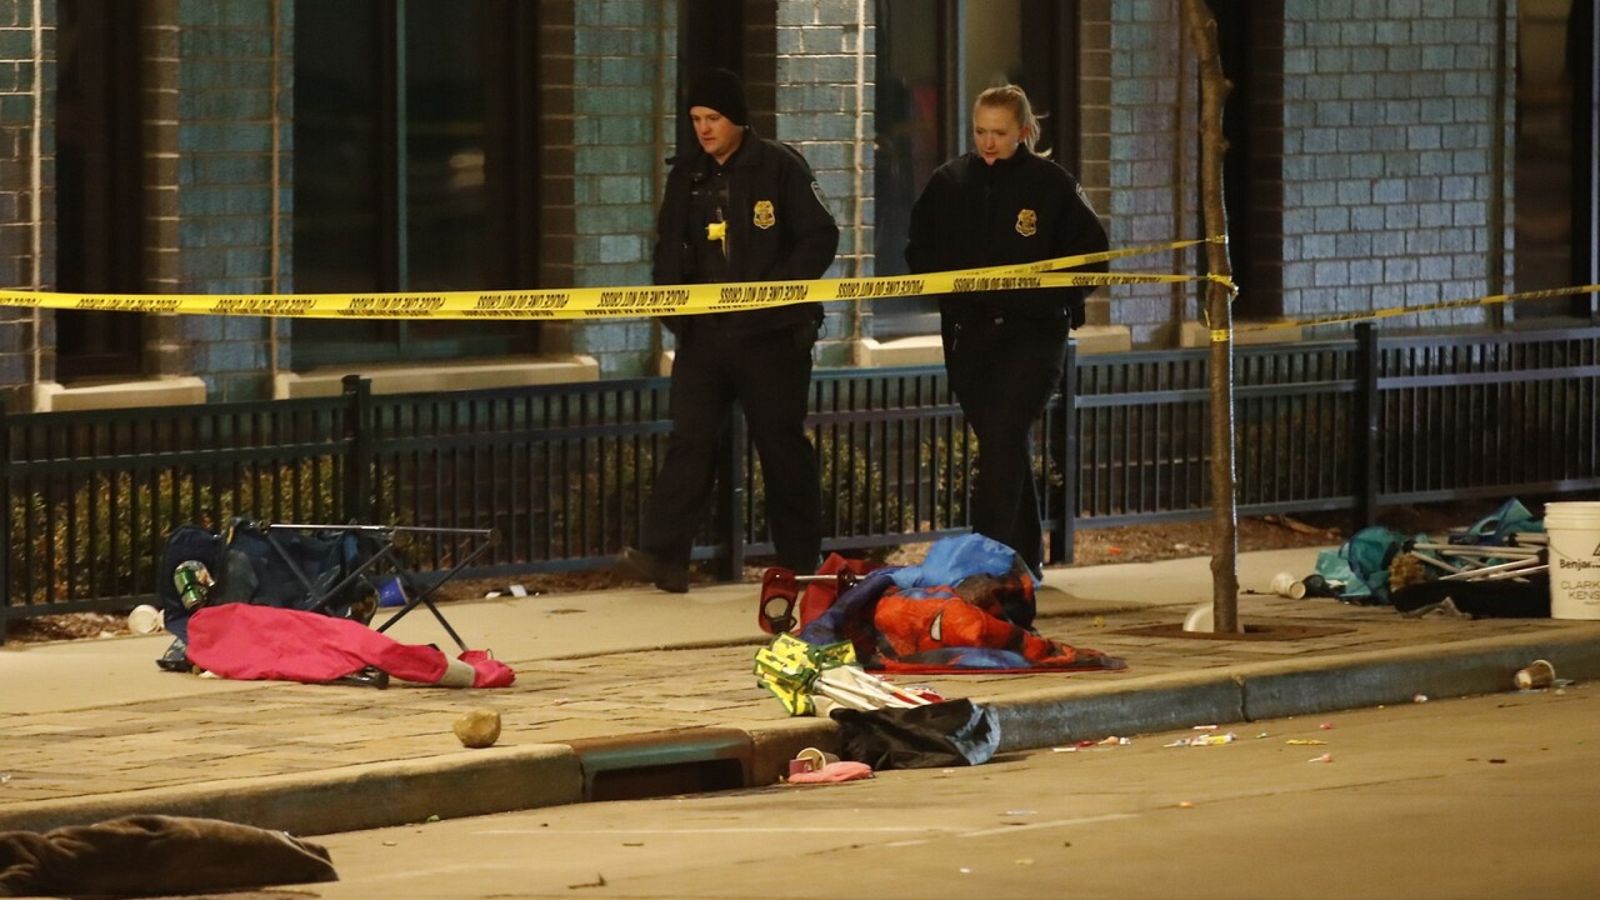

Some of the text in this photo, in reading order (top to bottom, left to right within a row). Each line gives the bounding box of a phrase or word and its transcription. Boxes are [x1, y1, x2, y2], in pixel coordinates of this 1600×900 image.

[597, 289, 689, 307] POLICE LINE DO NOT CROSS
[718, 284, 808, 303] POLICE LINE DO NOT CROSS
[836, 280, 924, 298] POLICE LINE DO NOT CROSS
